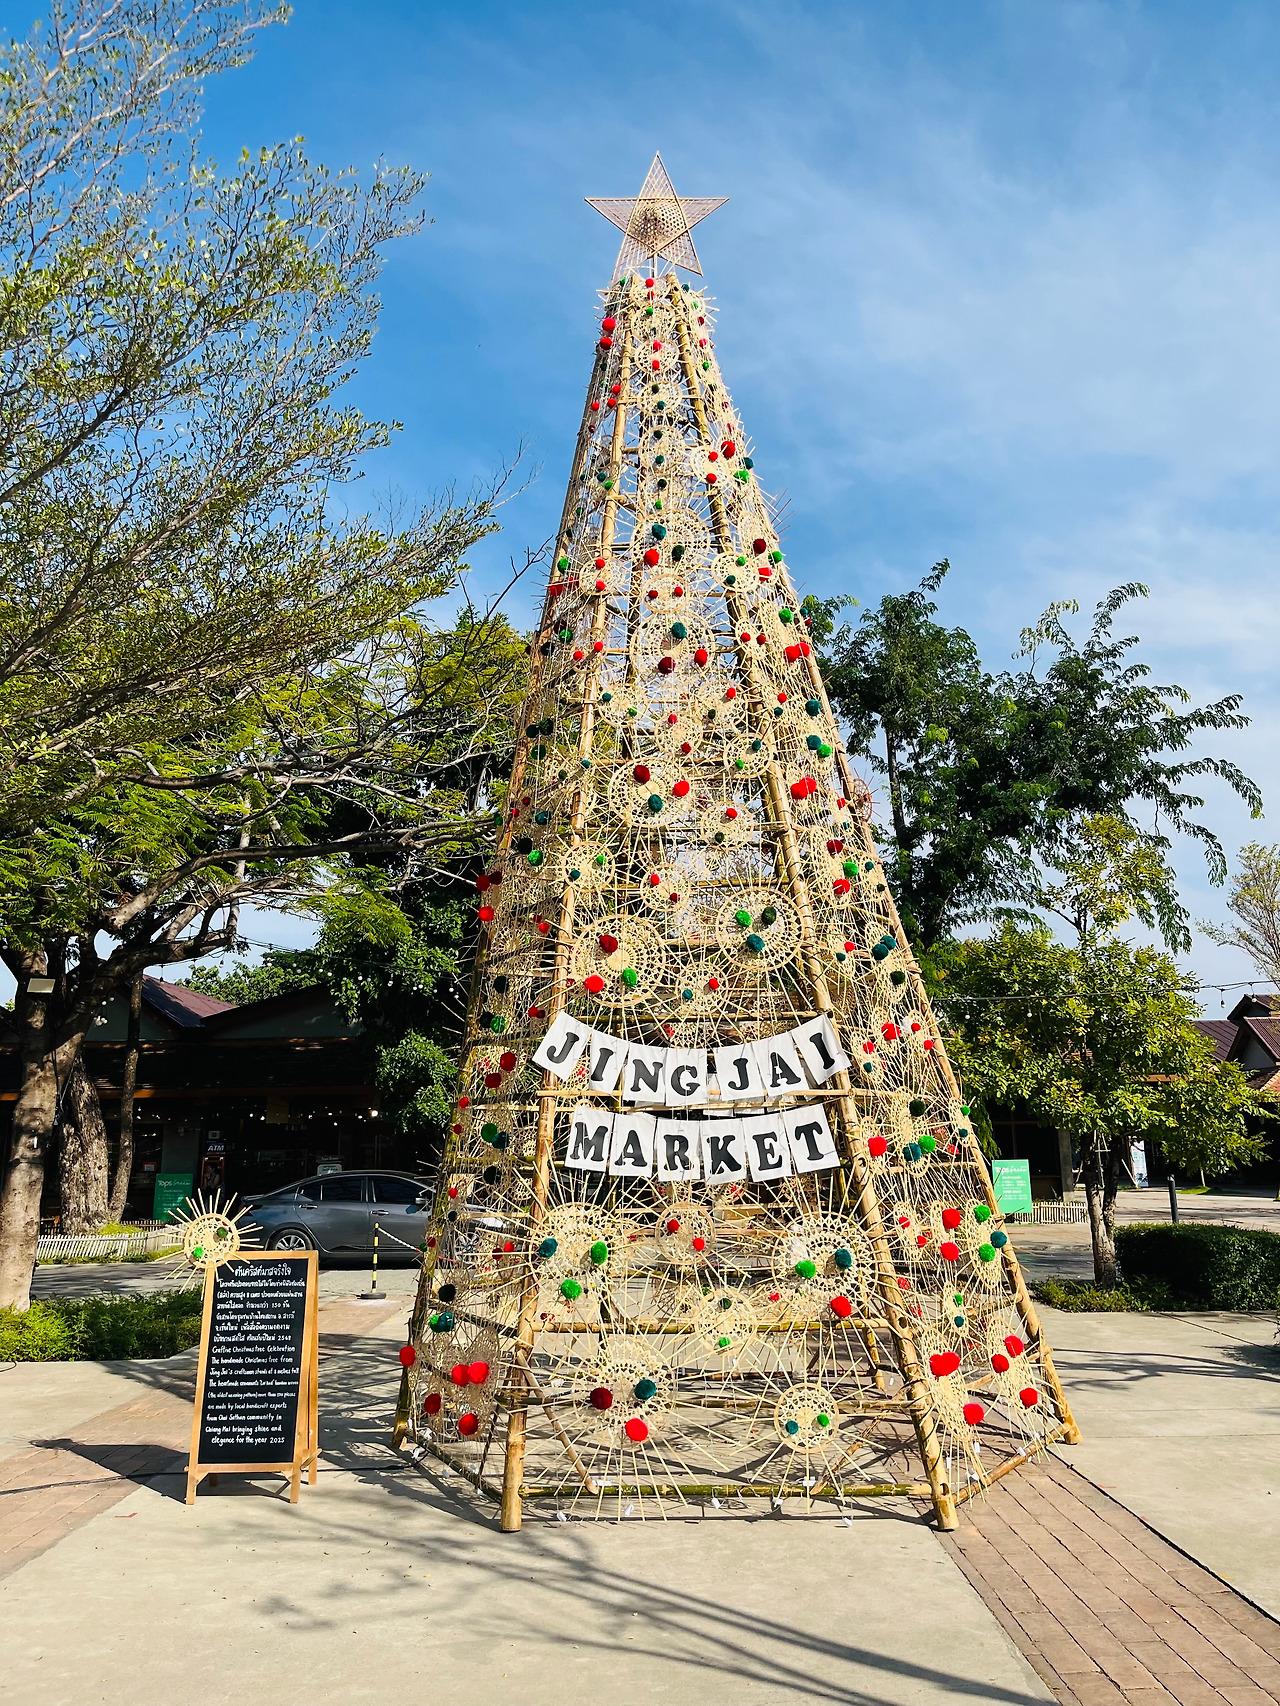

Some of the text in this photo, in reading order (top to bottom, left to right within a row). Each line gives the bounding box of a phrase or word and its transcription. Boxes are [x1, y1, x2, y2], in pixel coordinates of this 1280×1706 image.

[546, 1032, 836, 1096] JING JAI
[570, 1121, 825, 1175] MARKET
[158, 1180, 172, 1188] Tops
[267, 1345, 296, 1353] Celebration
[280, 1355, 294, 1363] from
[210, 1368, 220, 1377] Jing
[269, 1402, 287, 1410] experts
[247, 1413, 274, 1421] community
[205, 1426, 221, 1435] Chiang
[232, 1426, 252, 1435] bringing
[211, 1436, 234, 1446] elegance
[236, 1435, 244, 1443] for
